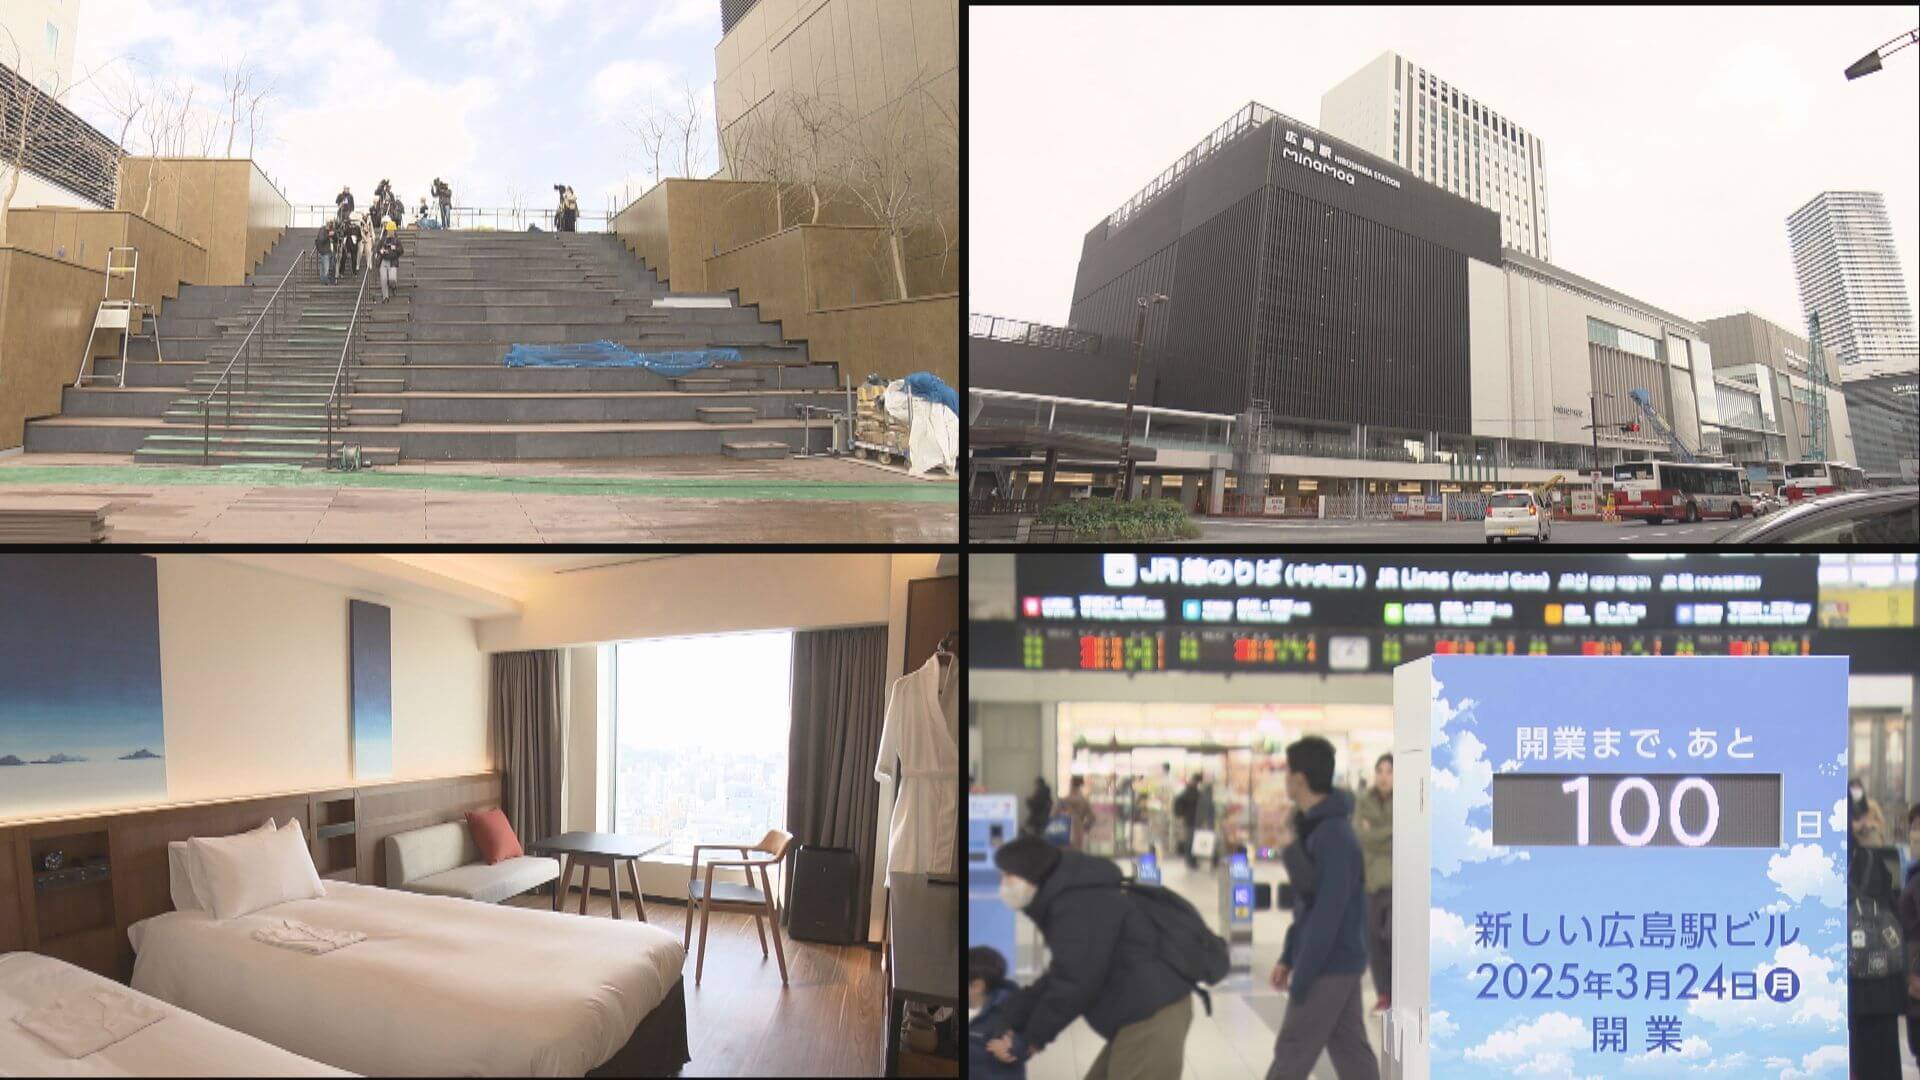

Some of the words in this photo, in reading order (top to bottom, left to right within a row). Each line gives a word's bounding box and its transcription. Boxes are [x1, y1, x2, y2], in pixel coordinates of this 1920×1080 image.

[1285, 130, 1331, 160] 広島駅
[1335, 154, 1373, 178] HIROSHIMA
[1374, 171, 1400, 189] STATION
[1516, 726, 1755, 760] 開業まで、あと
[1561, 775, 1720, 846] 100
[1797, 811, 1822, 839] 日
[1474, 910, 1800, 949] 新しい広島駅ビル
